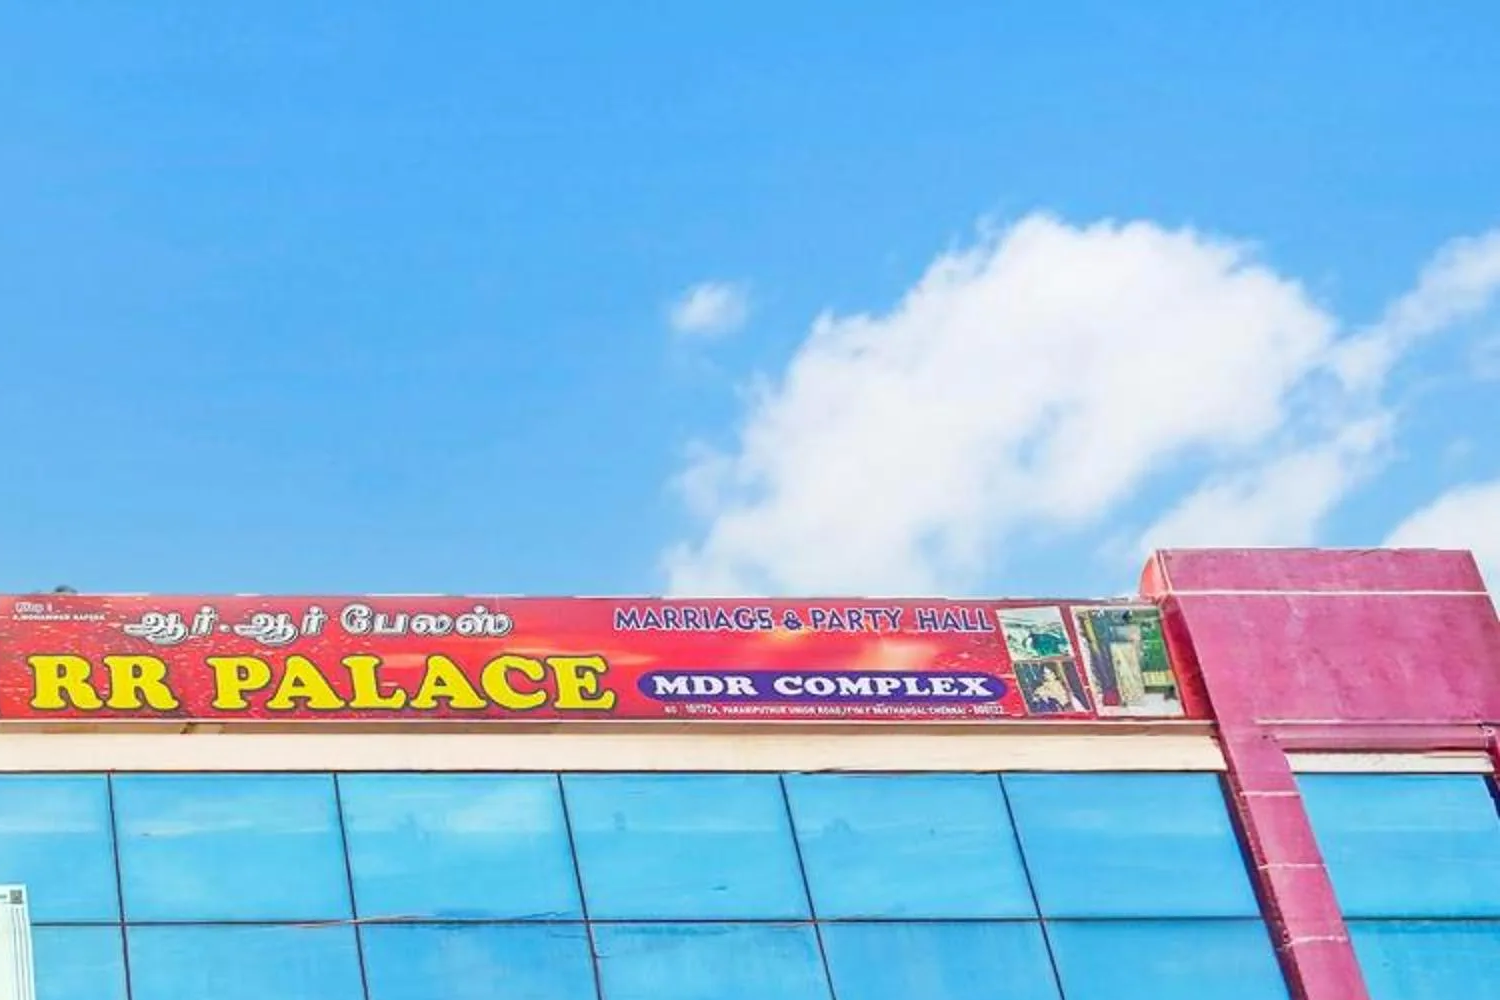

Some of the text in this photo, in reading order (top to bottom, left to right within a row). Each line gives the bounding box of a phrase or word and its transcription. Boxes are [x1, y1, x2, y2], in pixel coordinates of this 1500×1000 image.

[340, 603, 515, 636] பேலஸ்
[783, 610, 803, 631] &
[809, 607, 904, 632] PARTY
[916, 607, 997, 633] HALL
[26, 653, 617, 713] RR PALACE
[652, 675, 995, 697] MDR COMPLEX
